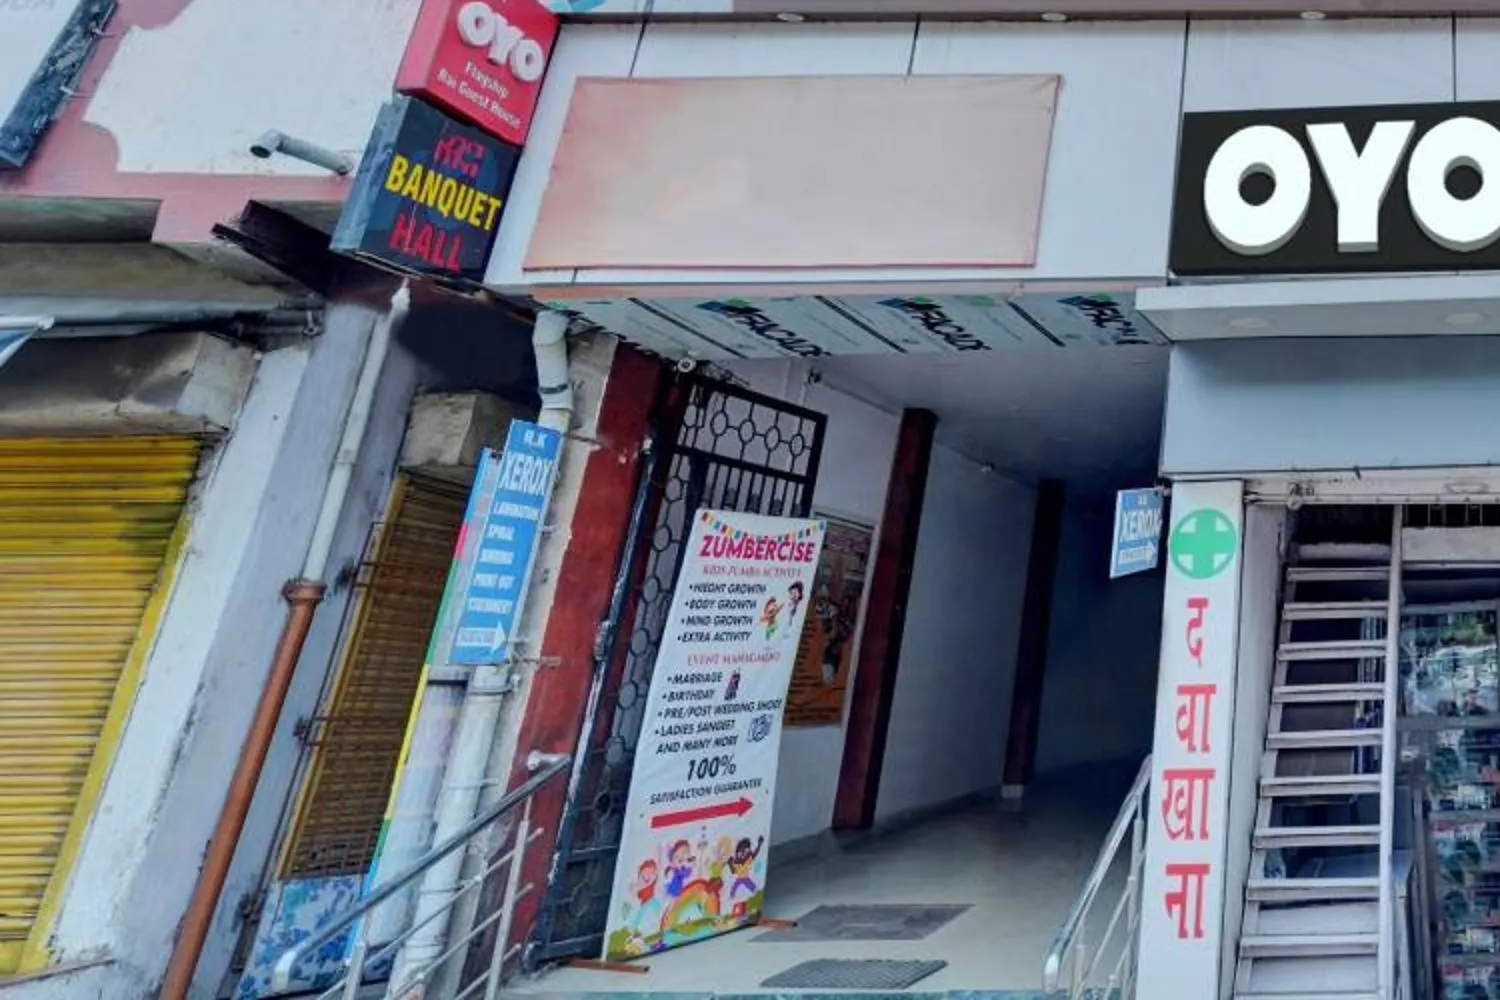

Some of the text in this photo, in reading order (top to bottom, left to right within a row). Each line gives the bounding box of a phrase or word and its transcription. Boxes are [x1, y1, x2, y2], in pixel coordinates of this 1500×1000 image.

[457, 1, 545, 82] OYO
[385, 153, 502, 232] BANQUET
[388, 213, 463, 274] HALL
[499, 452, 553, 496] XEROX
[699, 535, 815, 563] ZUMBERCISE
[727, 584, 766, 594] GROWTH
[689, 599, 757, 609] BODY GROWTH
[686, 615, 753, 626] MIND GROWTH
[682, 631, 752, 643] EXTRA ACTIVITY
[671, 671, 723, 684] MARRIAGE
[667, 689, 715, 701] BIRTHDAY
[663, 705, 712, 719] PRE/POST
[714, 702, 755, 715] WEDDING
[660, 723, 695, 736] LADIES
[656, 743, 681, 754] AND
[683, 739, 711, 751] MANY
[687, 754, 737, 782] 100%
[650, 785, 712, 805] SATISFACTION
